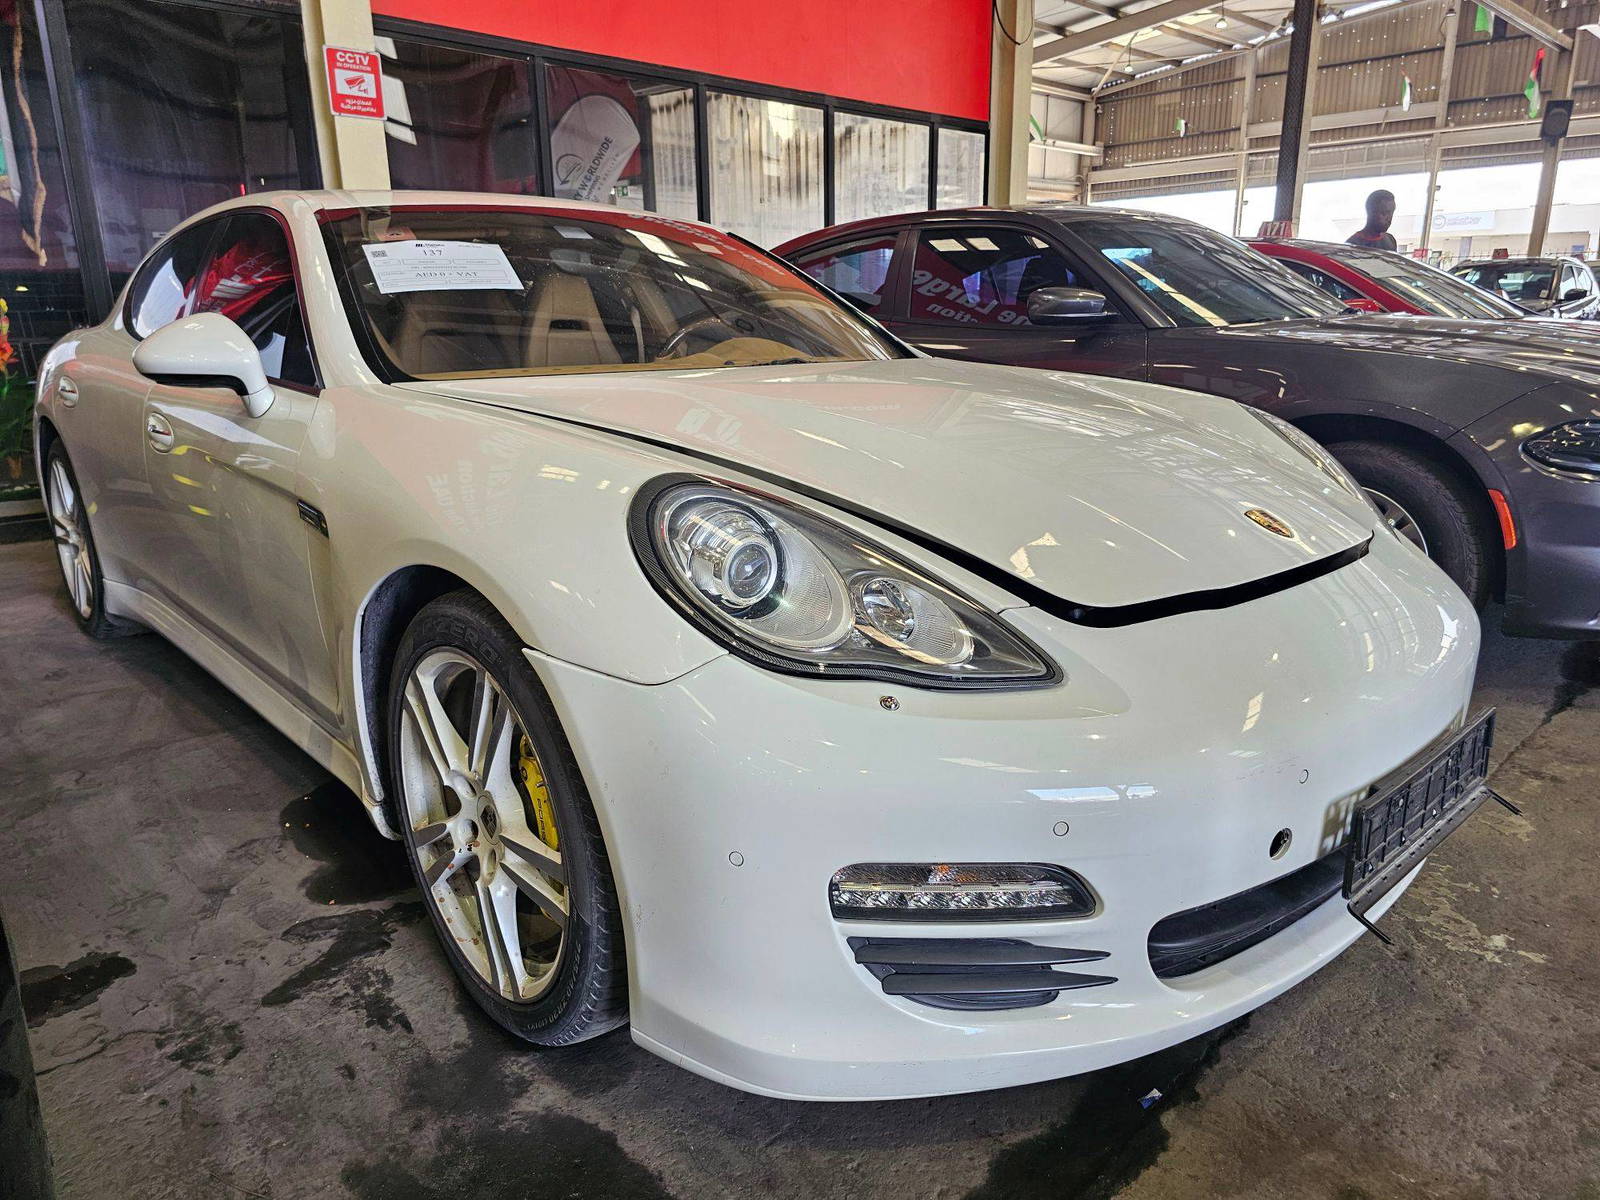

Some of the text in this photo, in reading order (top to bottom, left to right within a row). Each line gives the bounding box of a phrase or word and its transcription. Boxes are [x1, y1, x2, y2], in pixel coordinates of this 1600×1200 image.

[336, 51, 369, 66] CCTV
[343, 63, 372, 71] OPERATION
[578, 136, 614, 192] WORLDWIDE
